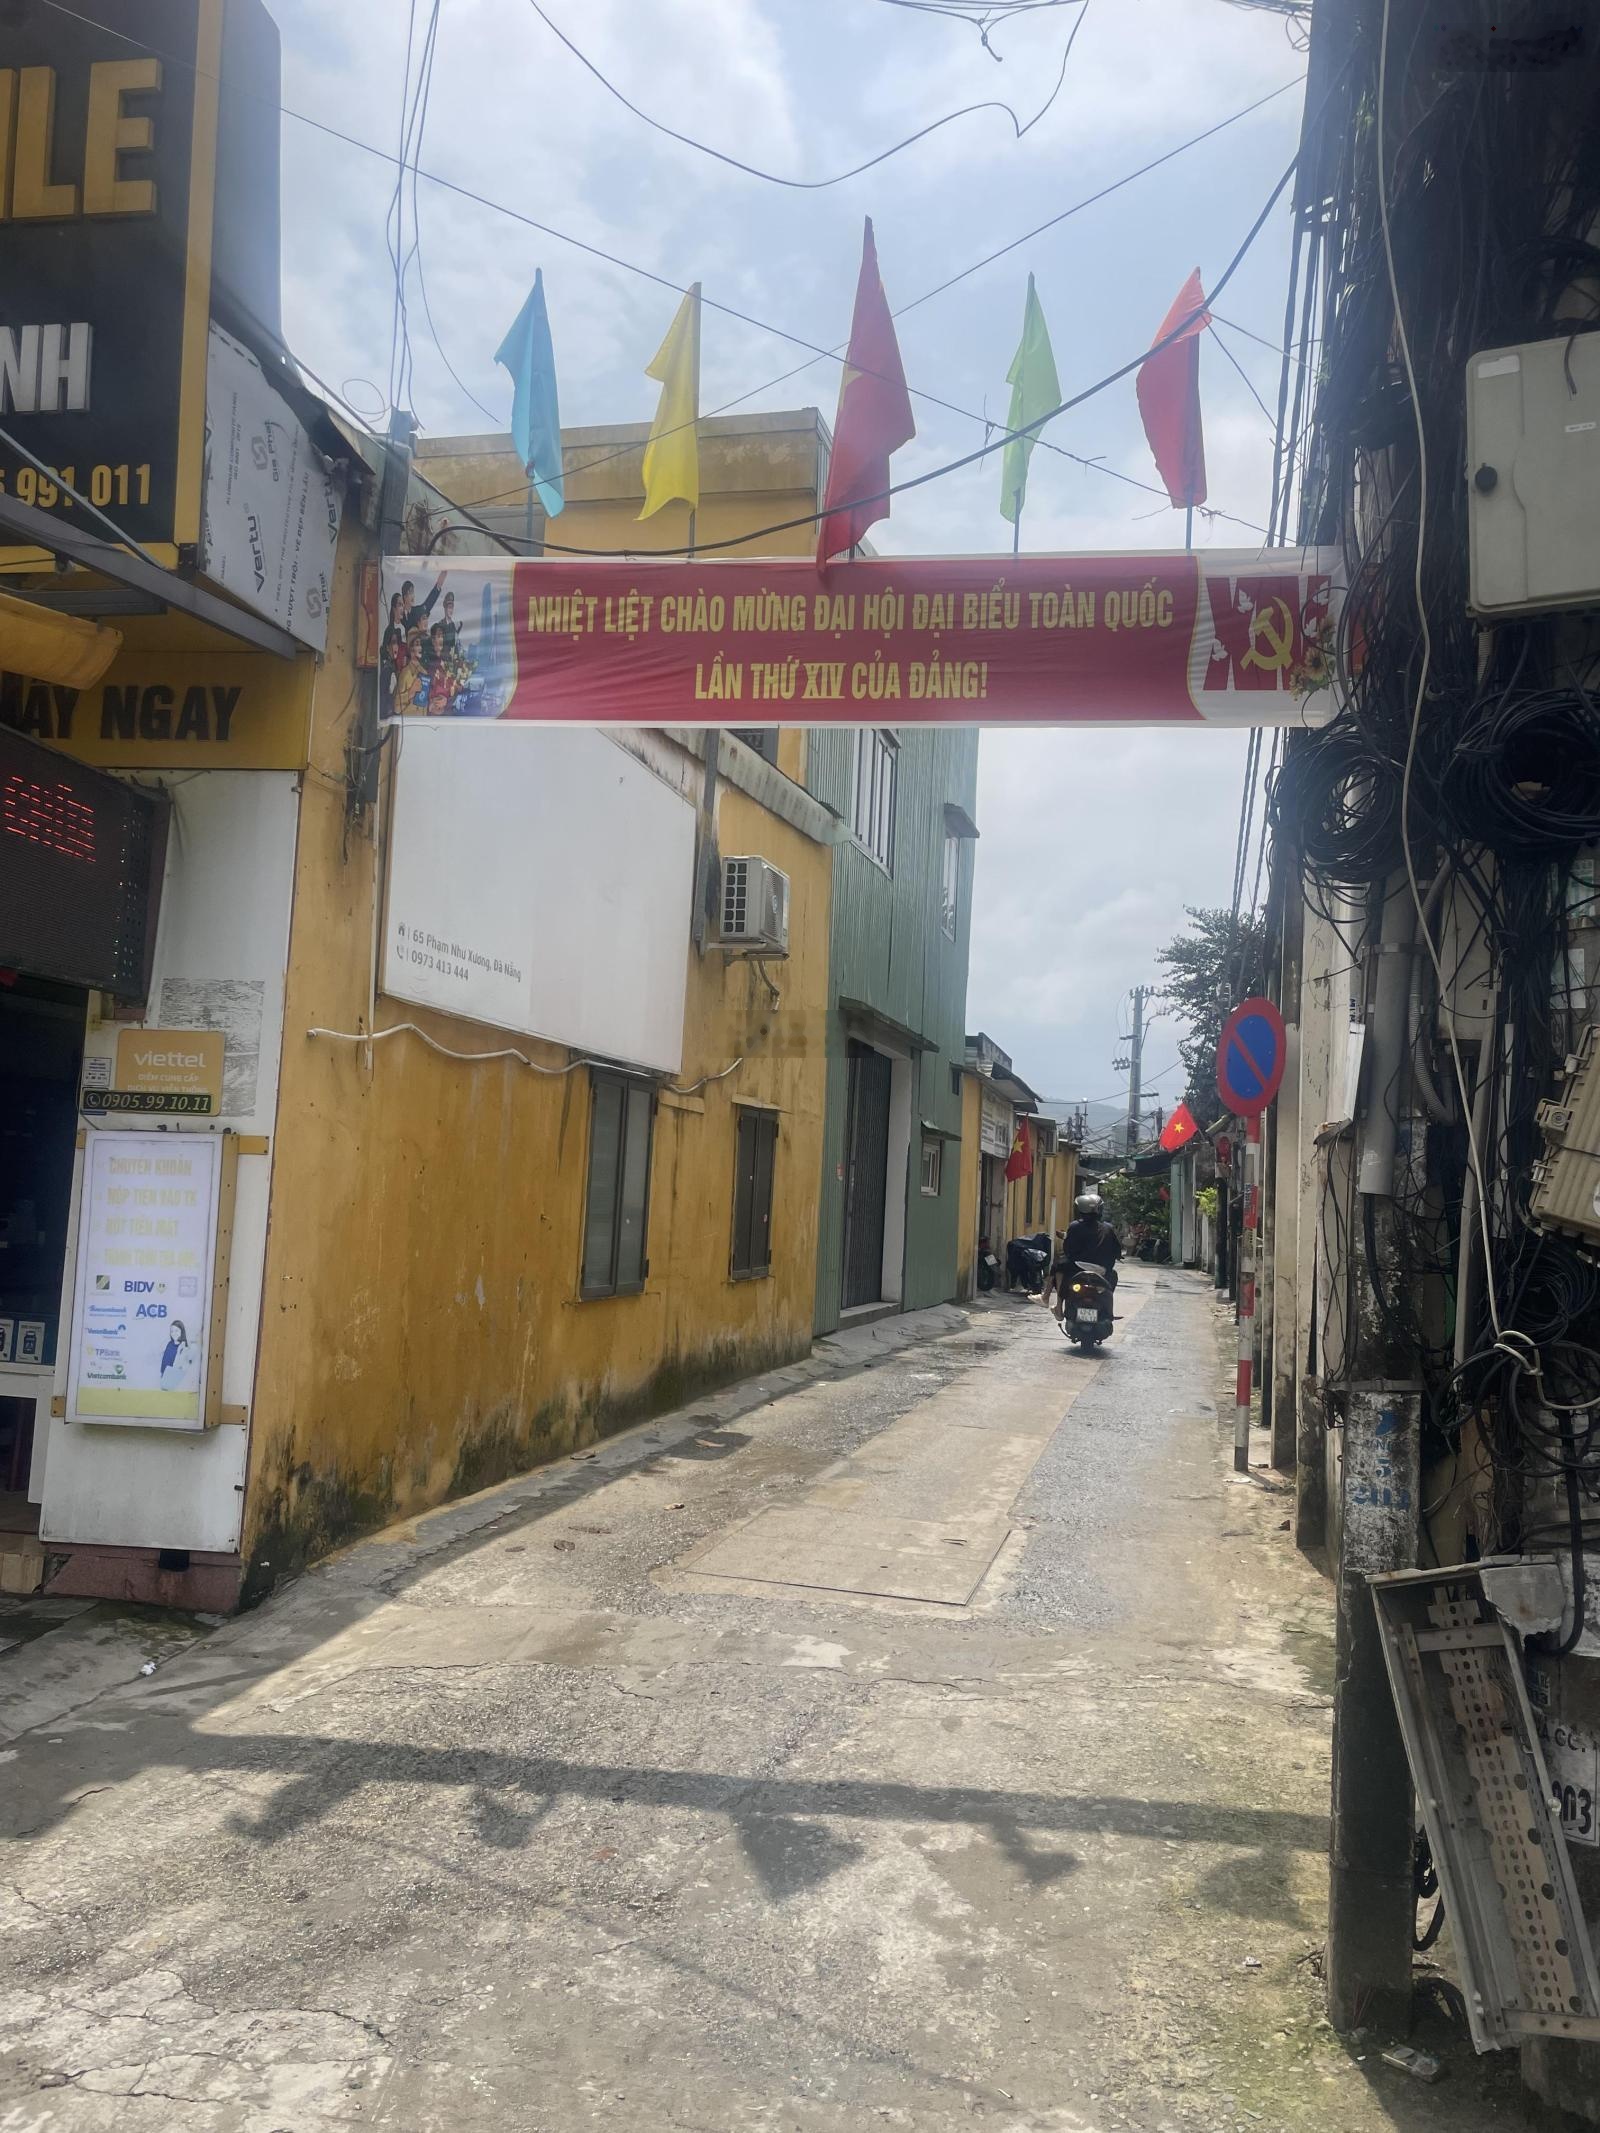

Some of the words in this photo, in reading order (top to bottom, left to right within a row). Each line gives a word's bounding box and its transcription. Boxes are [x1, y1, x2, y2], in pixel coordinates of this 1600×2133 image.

[248, 515, 265, 593] Vertu
[527, 588, 598, 641] NHIỆT
[604, 588, 654, 641] LIỆT
[660, 588, 725, 633] CHÀO
[732, 587, 806, 633] MỪNG
[814, 594, 856, 639] ĐẠI
[863, 586, 904, 639] HỘI
[912, 593, 954, 639] ĐẠI
[963, 577, 1021, 630] BIỂU
[1028, 583, 1096, 630] TOÀN
[1103, 577, 1174, 632] QUỐC
[695, 650, 743, 700] LẦN
[750, 655, 800, 700] THỨ
[801, 662, 847, 699] XIV
[851, 649, 901, 700] CỦA
[909, 649, 988, 699] ĐẢNG!
[100, 685, 242, 741] NGAY
[411, 950, 434, 969] 0973
[436, 959, 451, 975] 413
[454, 965, 469, 981] 444
[413, 929, 424, 945] 65
[426, 933, 449, 954] Phạm
[451, 943, 467, 960] Như
[493, 958, 503, 973] Đà
[134, 1051, 206, 1068] viettel
[102, 1093, 209, 1111] 0905.99.10.11
[124, 1280, 154, 1293] BIDV
[136, 1303, 167, 1318] ACB
